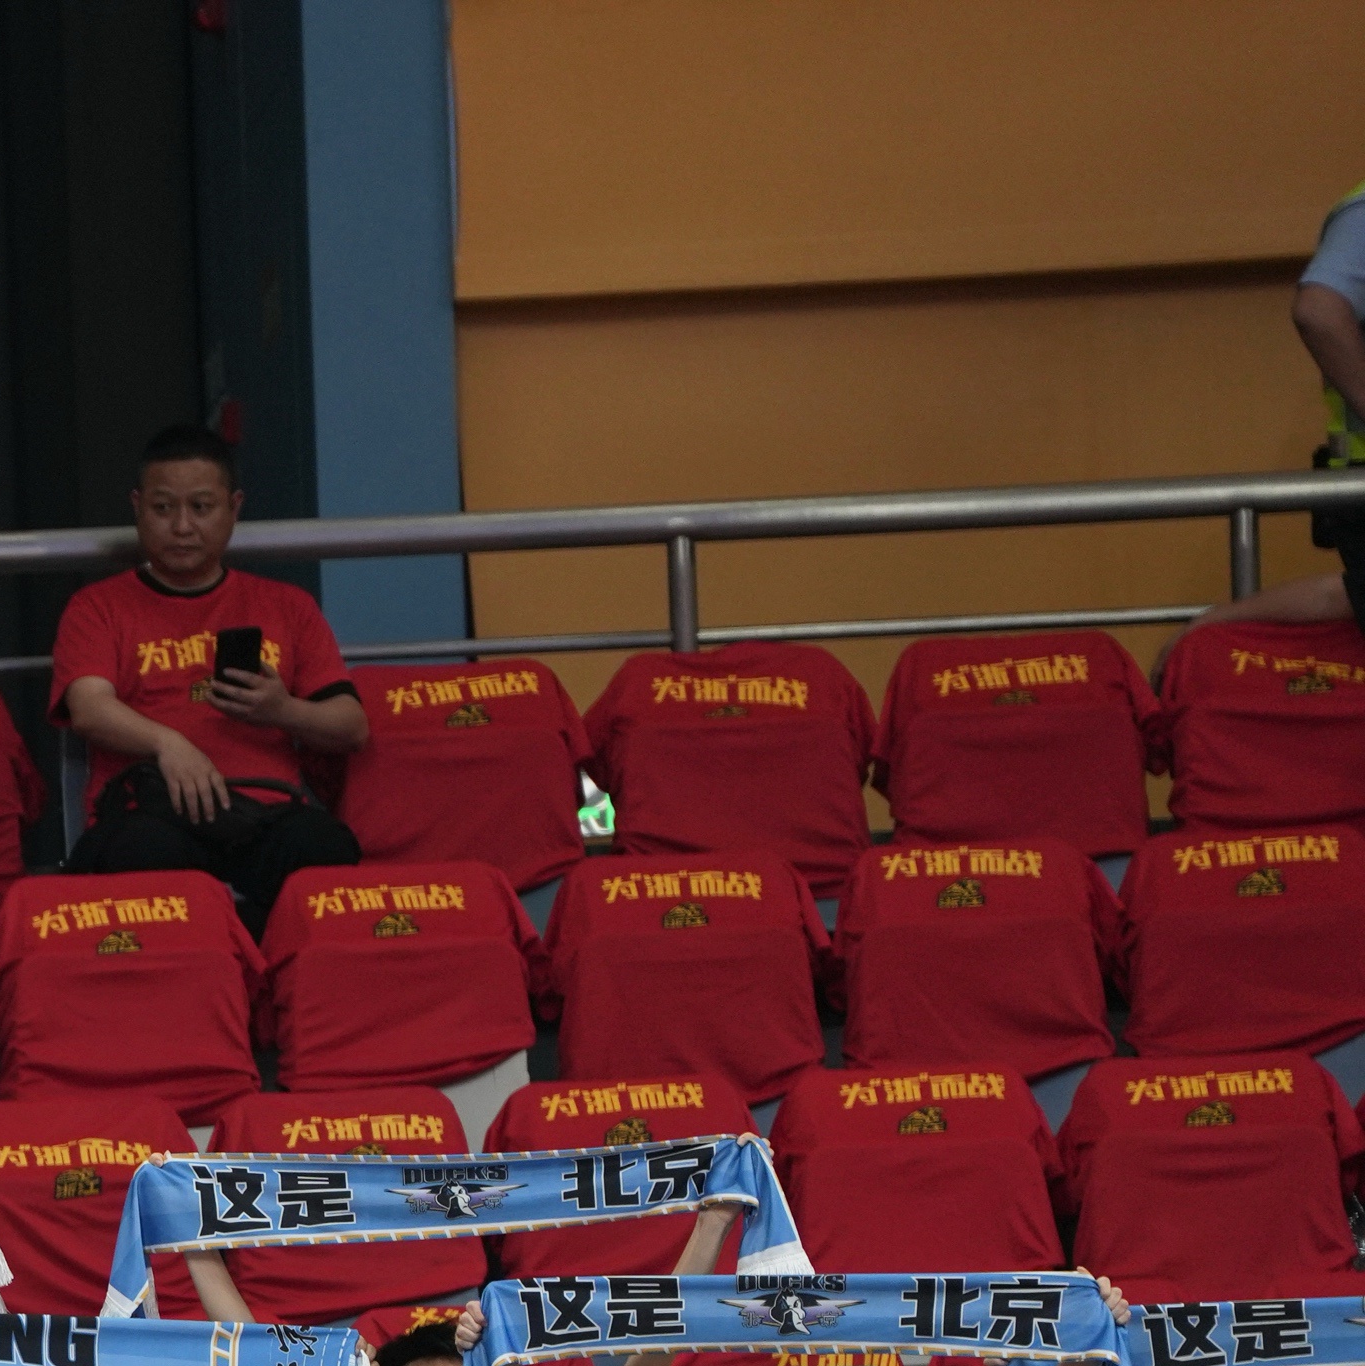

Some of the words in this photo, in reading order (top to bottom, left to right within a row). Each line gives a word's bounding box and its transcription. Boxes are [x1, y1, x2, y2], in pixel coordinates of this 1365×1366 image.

[192, 1163, 357, 1240] 这是
[561, 1144, 719, 1212] 北京
[401, 1163, 509, 1185] DUCKS
[736, 1274, 847, 1295] DUCKS
[518, 1276, 686, 1351] 这是
[898, 1274, 1070, 1348] 北京
